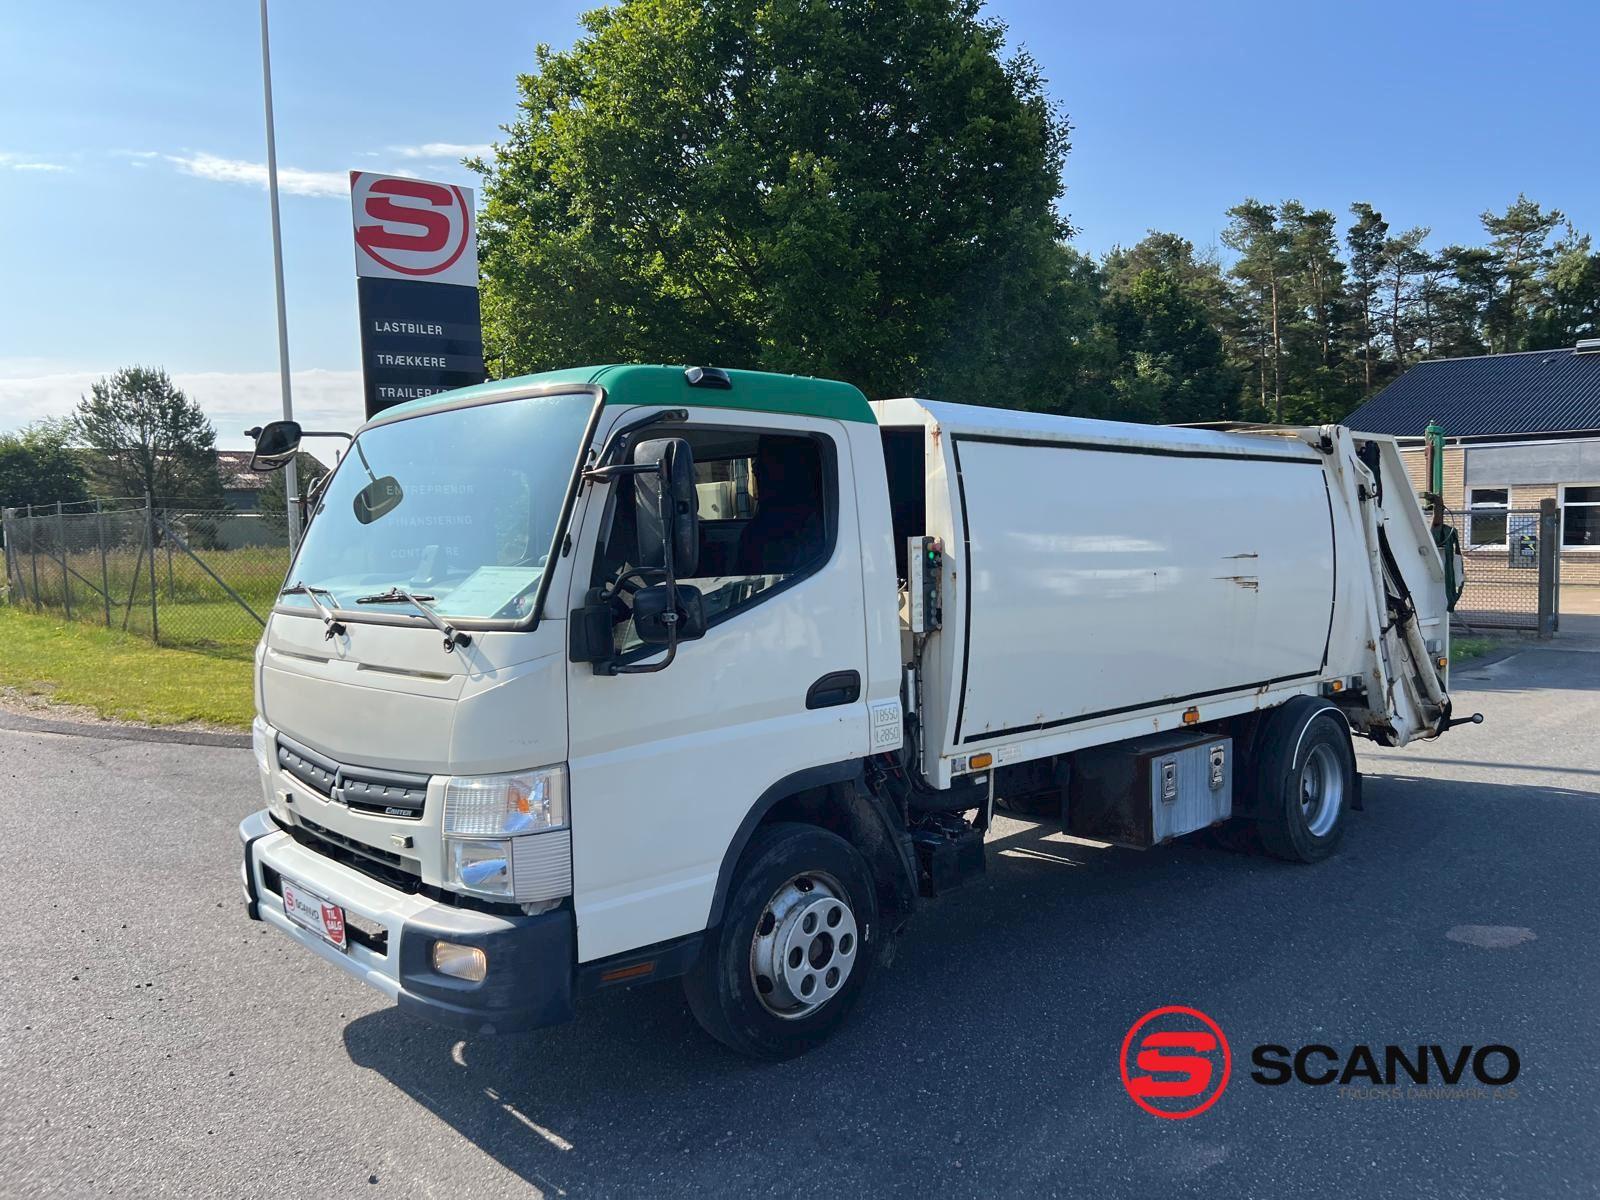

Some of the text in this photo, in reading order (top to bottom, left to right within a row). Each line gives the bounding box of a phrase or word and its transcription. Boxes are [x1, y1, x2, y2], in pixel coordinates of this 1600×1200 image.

[358, 178, 453, 253] S
[375, 321, 443, 336] LASTBILER
[377, 354, 447, 368] TRÆKKERE
[379, 387, 432, 398] TRAILER
[326, 909, 338, 920] TIL
